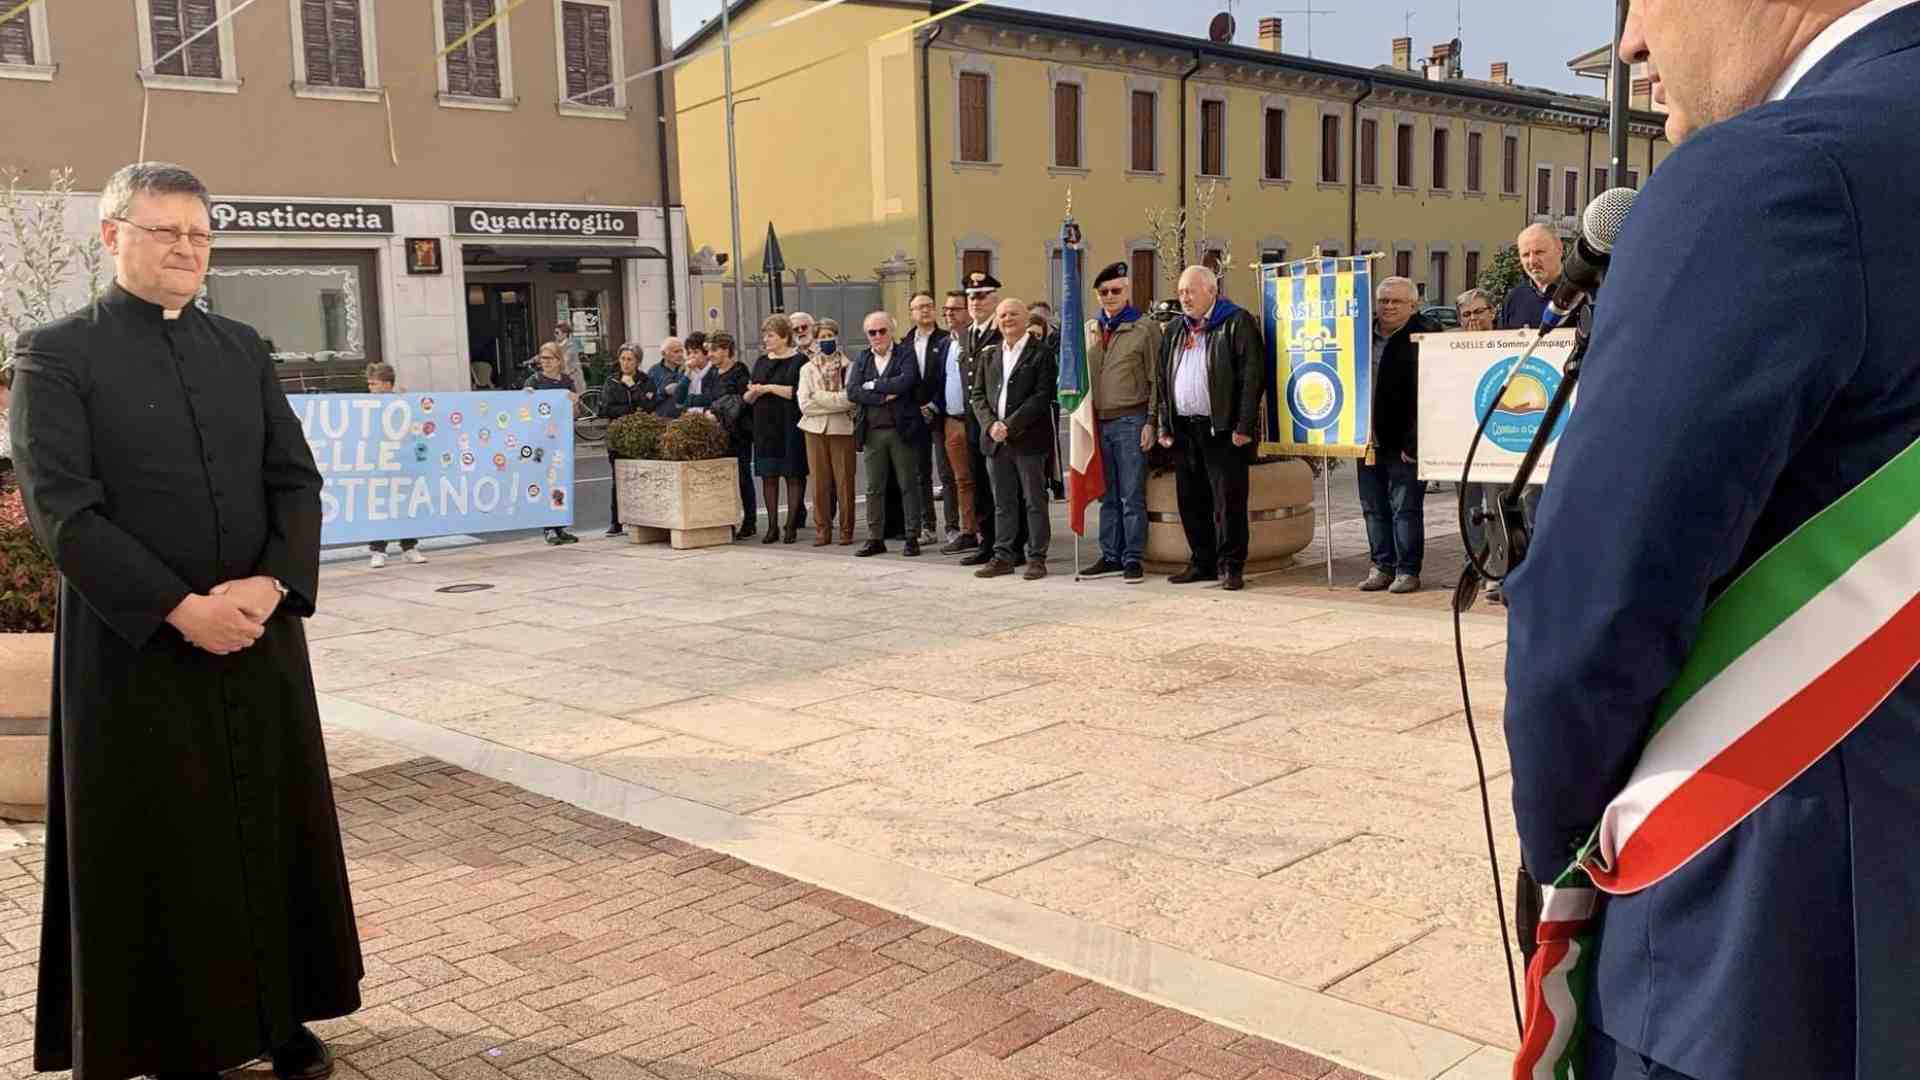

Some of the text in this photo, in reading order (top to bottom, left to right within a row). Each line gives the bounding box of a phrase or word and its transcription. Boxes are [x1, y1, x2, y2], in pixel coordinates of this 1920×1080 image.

[211, 203, 383, 230] Pasticceria
[469, 210, 625, 234] Quadrifoglio
[1450, 338, 1576, 350] CASELLE di Sommaampagna
